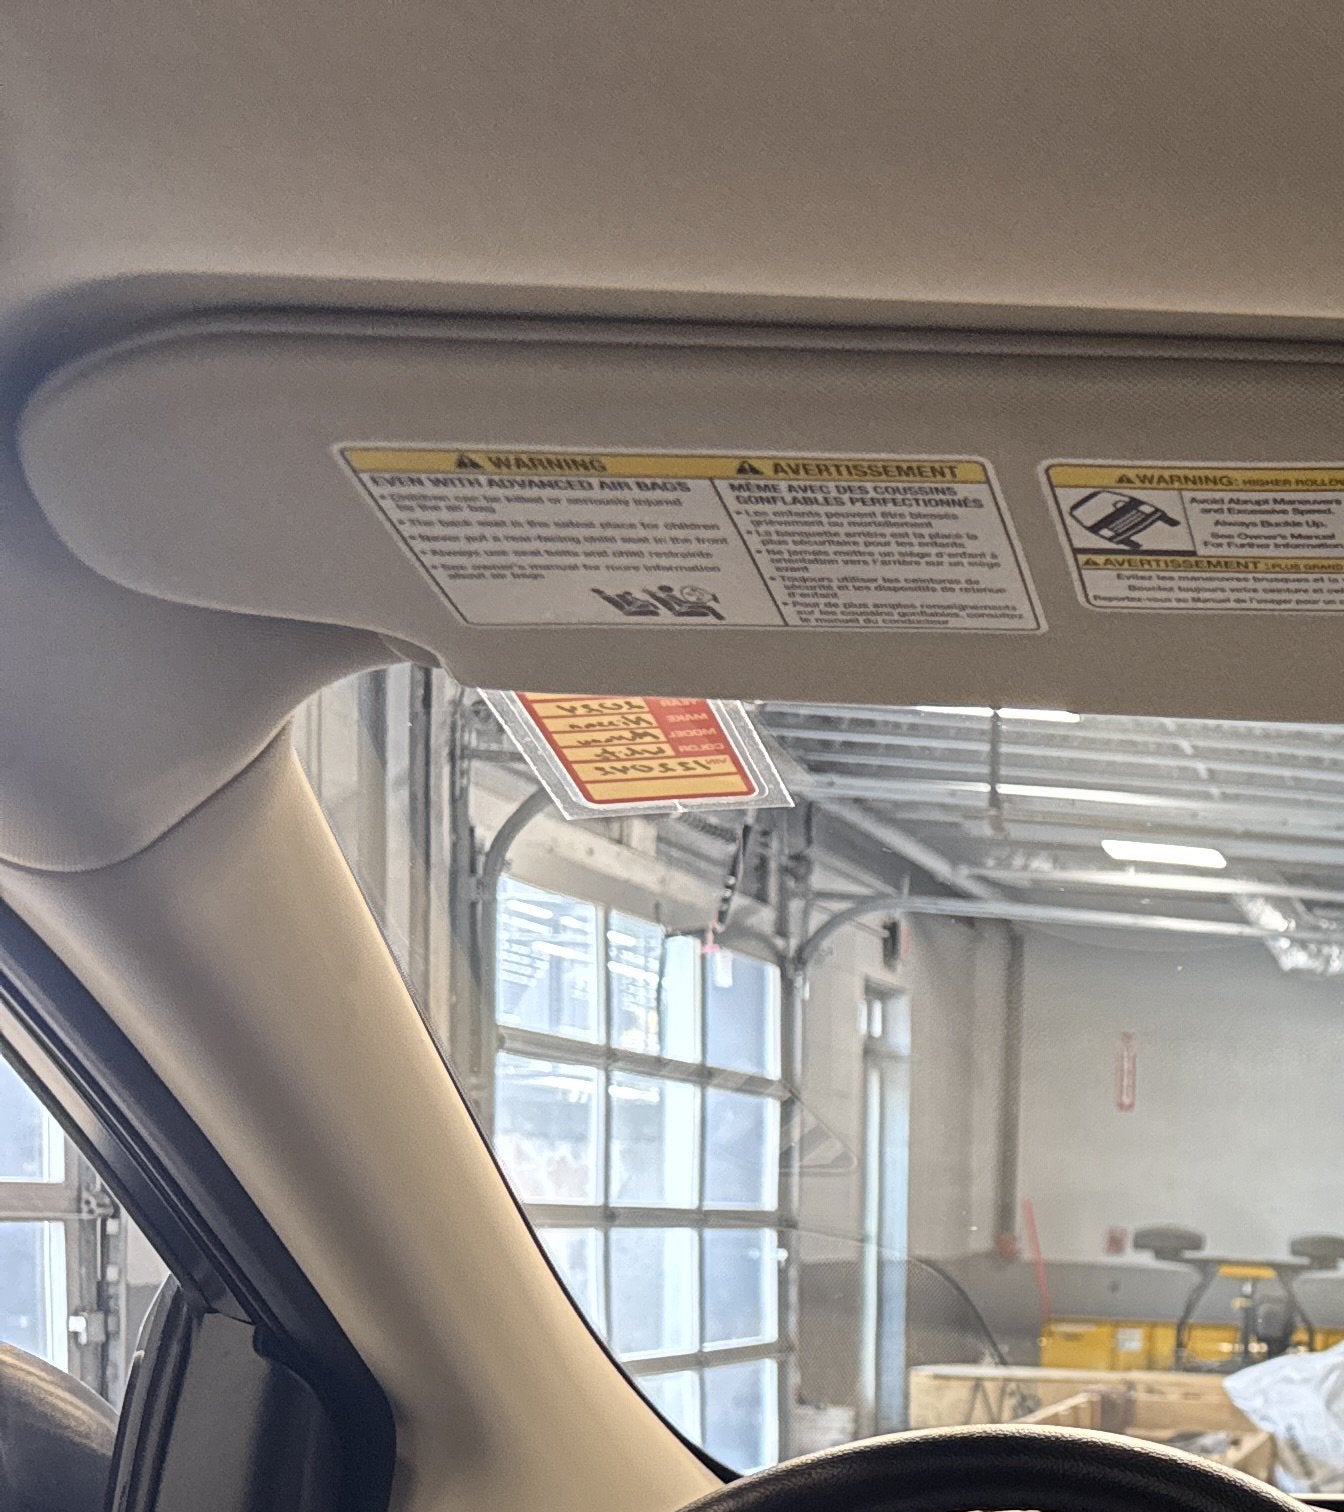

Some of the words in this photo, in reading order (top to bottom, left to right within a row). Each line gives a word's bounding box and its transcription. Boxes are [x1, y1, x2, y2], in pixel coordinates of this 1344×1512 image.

[488, 455, 608, 473] WARNING
[773, 462, 958, 480] AVERTISSEMENT
[369, 476, 424, 488] EVEN
[428, 477, 481, 489] WITH
[487, 478, 594, 492] ADVANCED
[600, 480, 633, 492] AIR
[638, 481, 691, 493] BAGS
[1136, 473, 1240, 488] WARNING:
[788, 484, 832, 495] AVEC
[835, 485, 870, 496] DES
[873, 486, 958, 497] COUSSINS
[1103, 557, 1261, 570] AVERTISSEMENT
